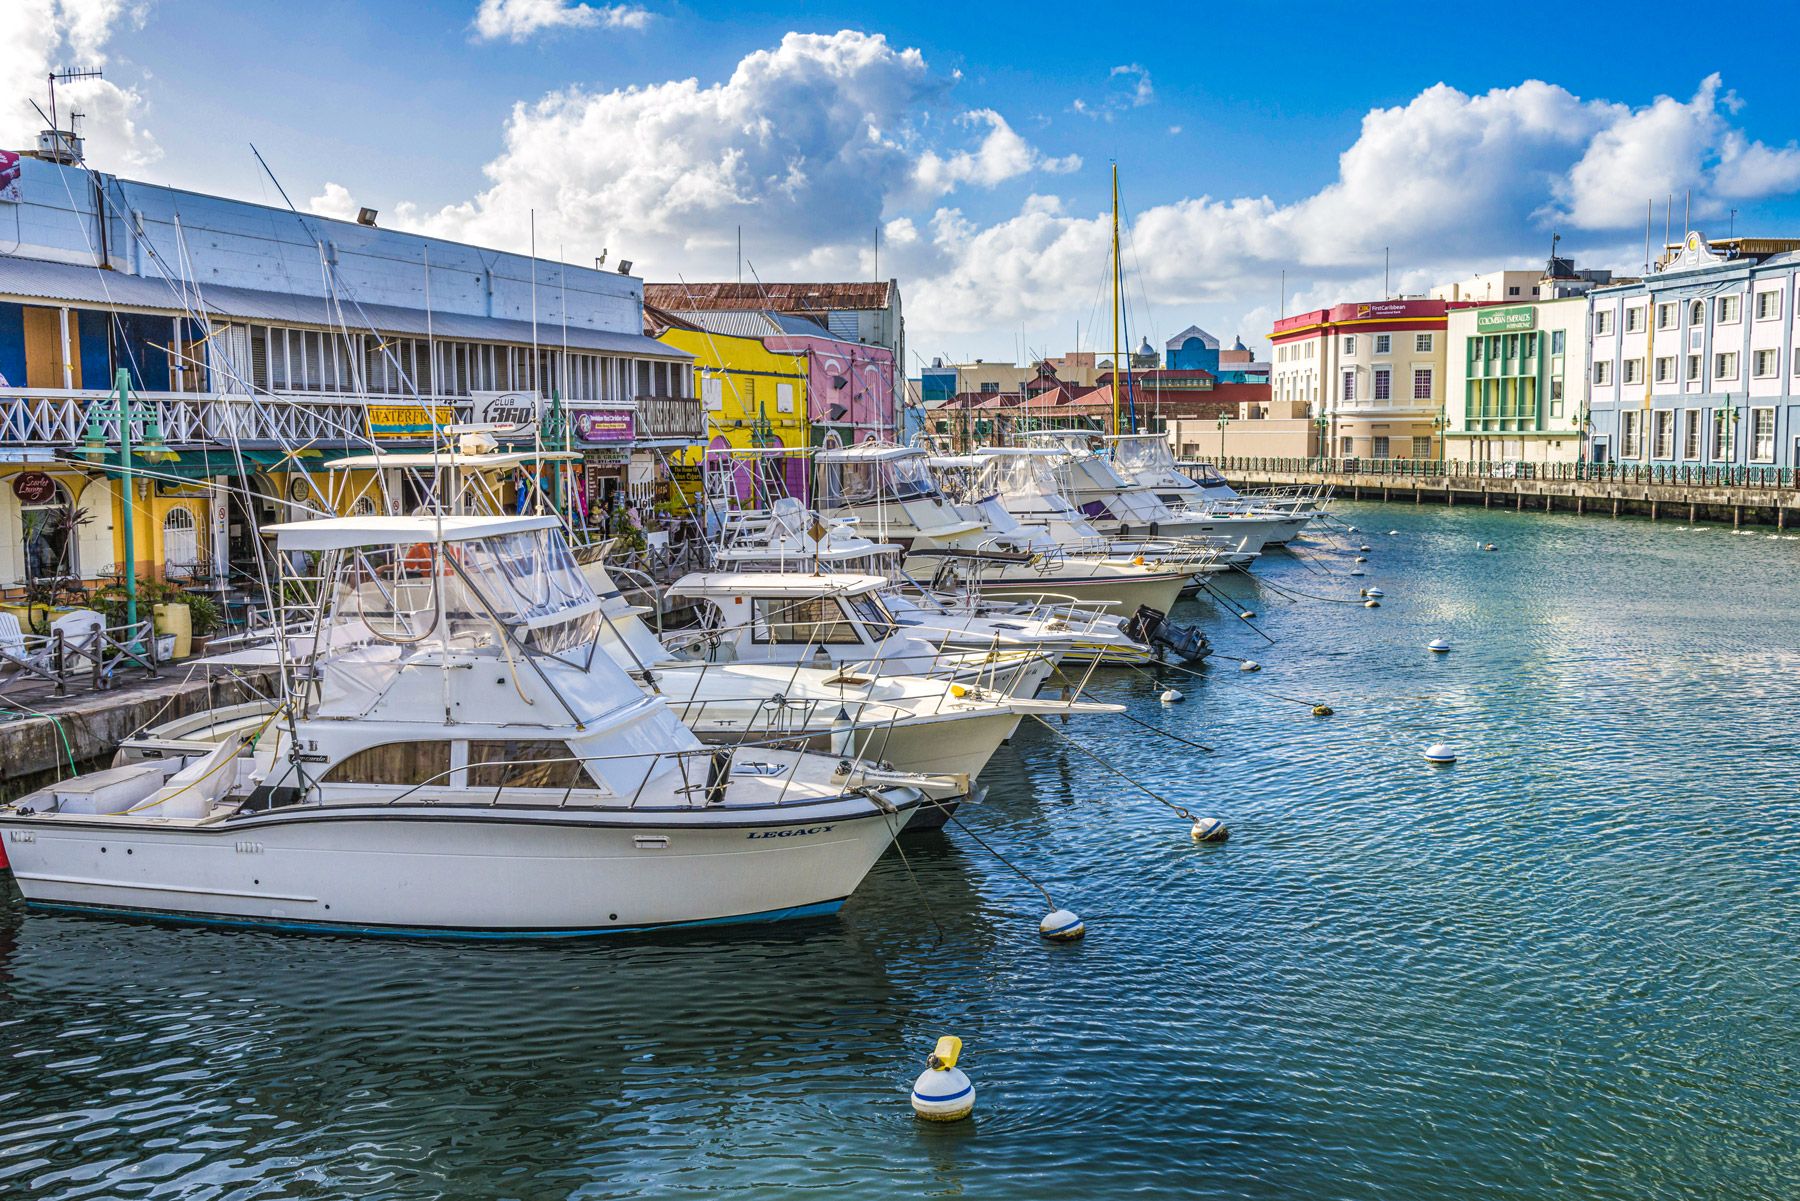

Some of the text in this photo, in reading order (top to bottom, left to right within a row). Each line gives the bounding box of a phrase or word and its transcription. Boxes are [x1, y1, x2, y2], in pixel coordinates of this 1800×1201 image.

[1371, 304, 1406, 312] FirstCaribbean
[494, 398, 515, 406] CLUB
[26, 475, 49, 488] Scarlet
[18, 482, 44, 500] Lounge
[746, 824, 837, 839] LEGACY
